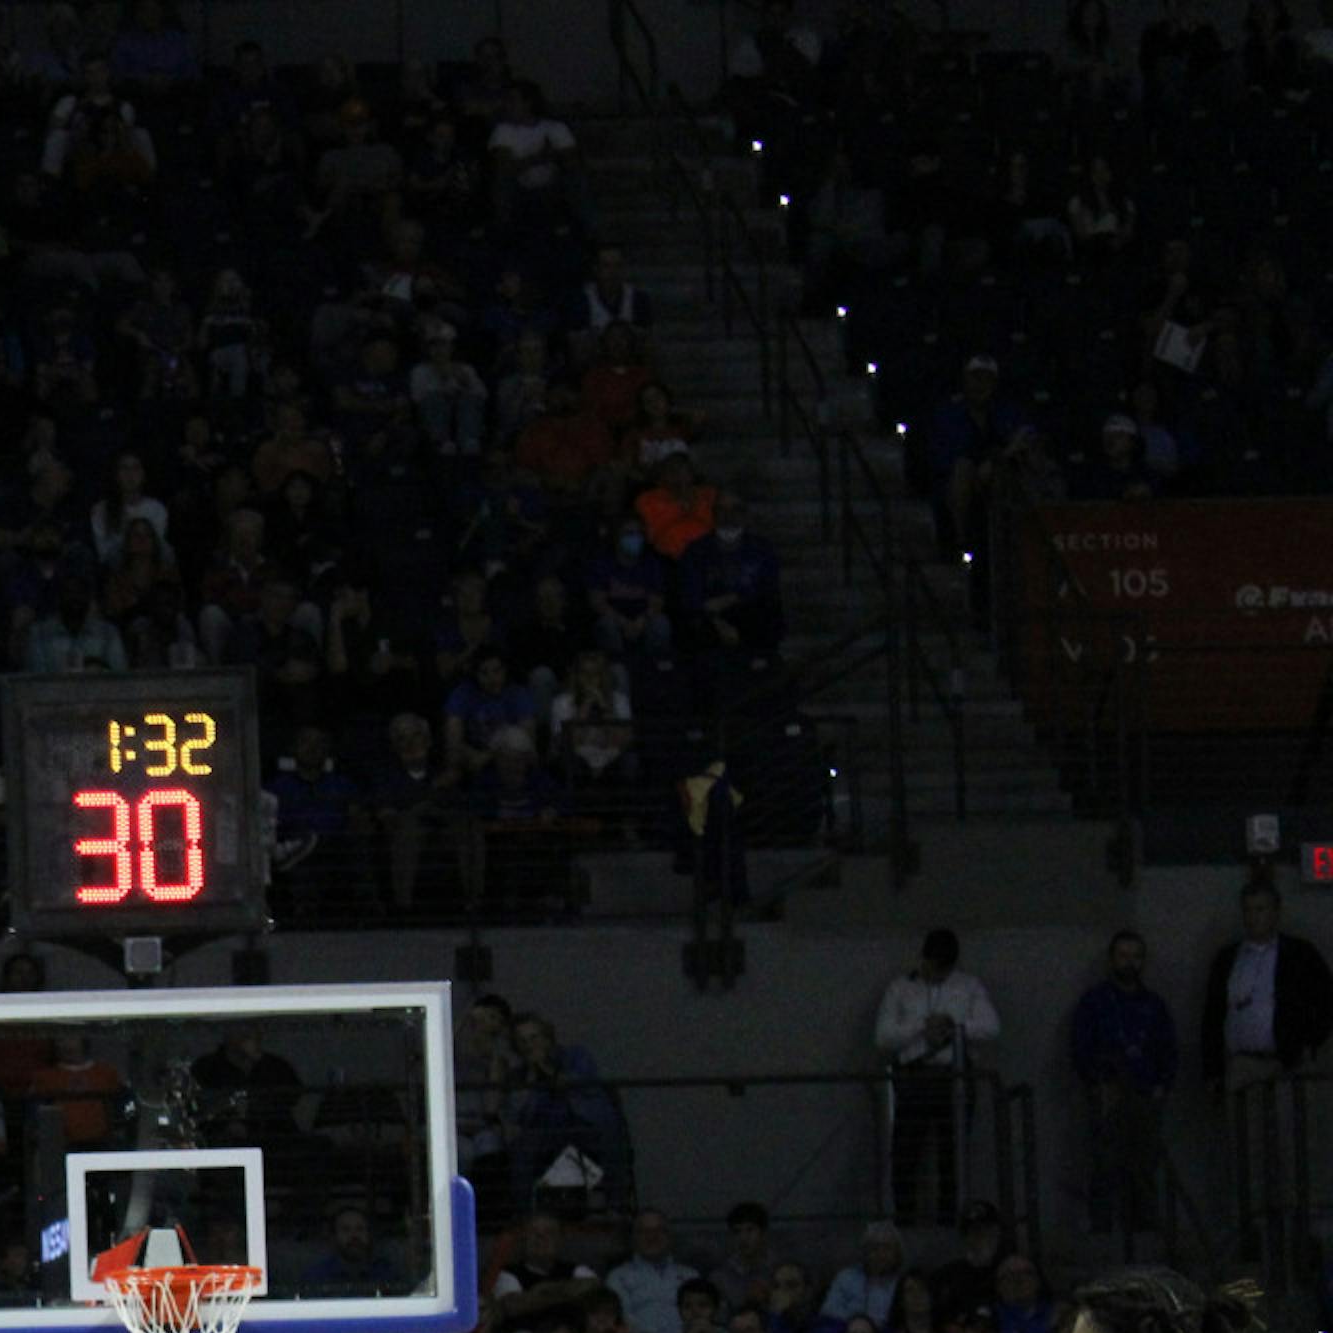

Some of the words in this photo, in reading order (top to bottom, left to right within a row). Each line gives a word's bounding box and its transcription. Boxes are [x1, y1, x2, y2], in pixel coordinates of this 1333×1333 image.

[1052, 532, 1159, 550] SECTION
[1109, 568, 1171, 599] 105
[108, 711, 218, 777] 1:32
[73, 787, 206, 903] 30
